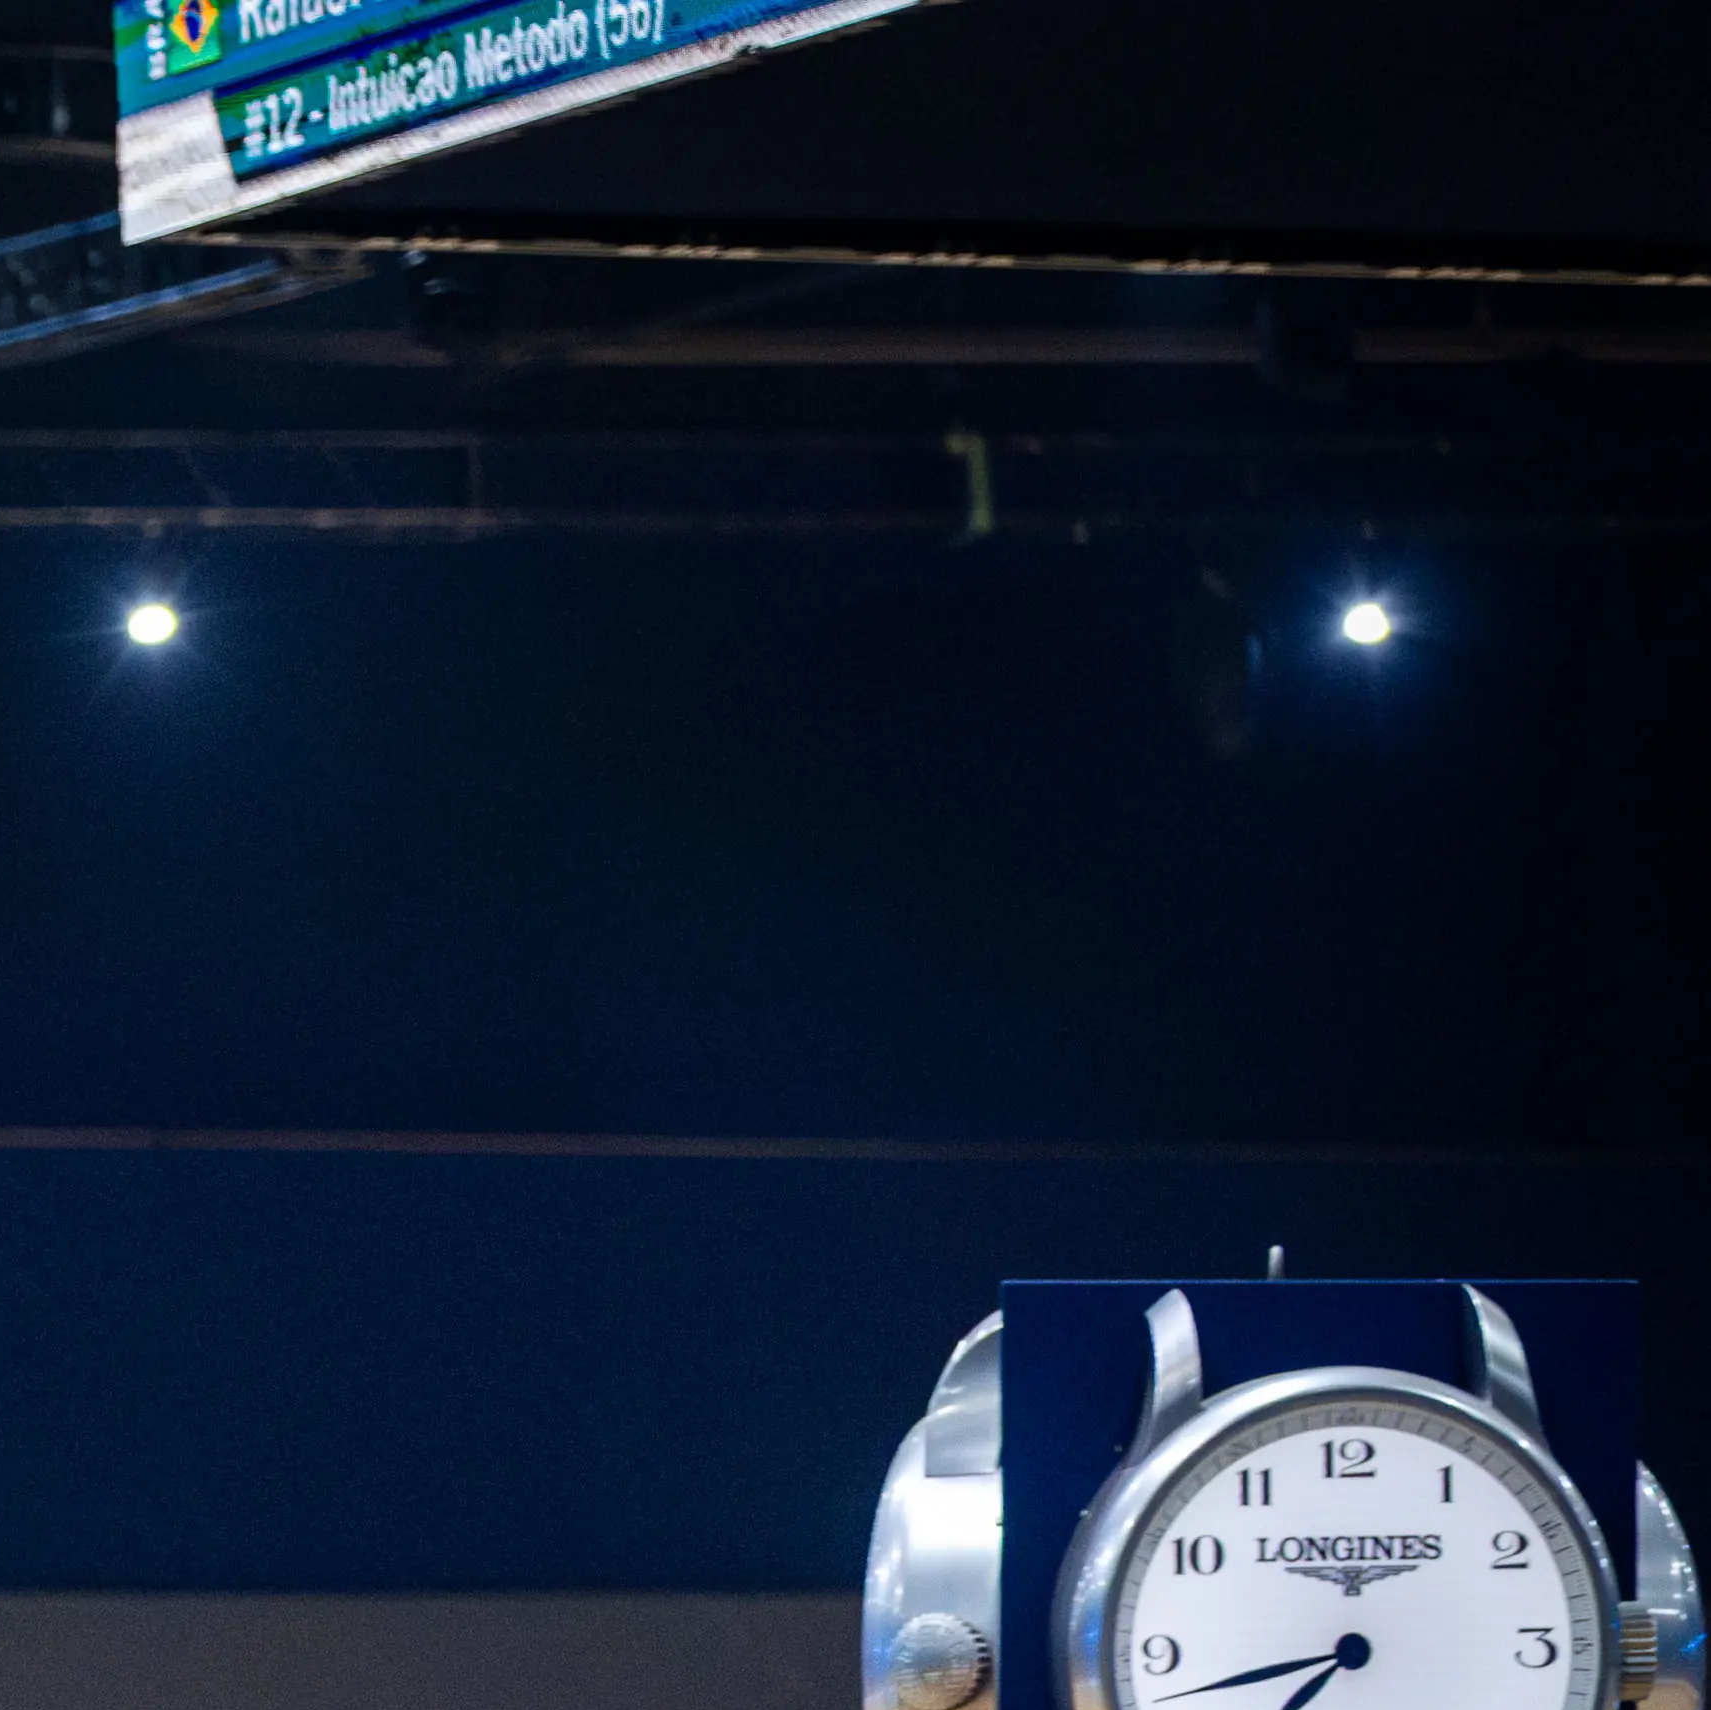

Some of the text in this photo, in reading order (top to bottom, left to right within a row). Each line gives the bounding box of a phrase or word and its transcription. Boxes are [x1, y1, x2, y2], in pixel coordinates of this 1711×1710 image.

[243, 86, 306, 160] #12
[327, 51, 458, 133] Intuicao
[464, 0, 588, 89] Metodo
[1237, 1438, 1454, 1506] 11 12 1
[1172, 1534, 1225, 1576] 10
[1255, 1533, 1443, 1565] LONGINES
[1490, 1529, 1530, 1570] 2
[1141, 1634, 1182, 1676] 9
[1514, 1626, 1558, 1669] 3
